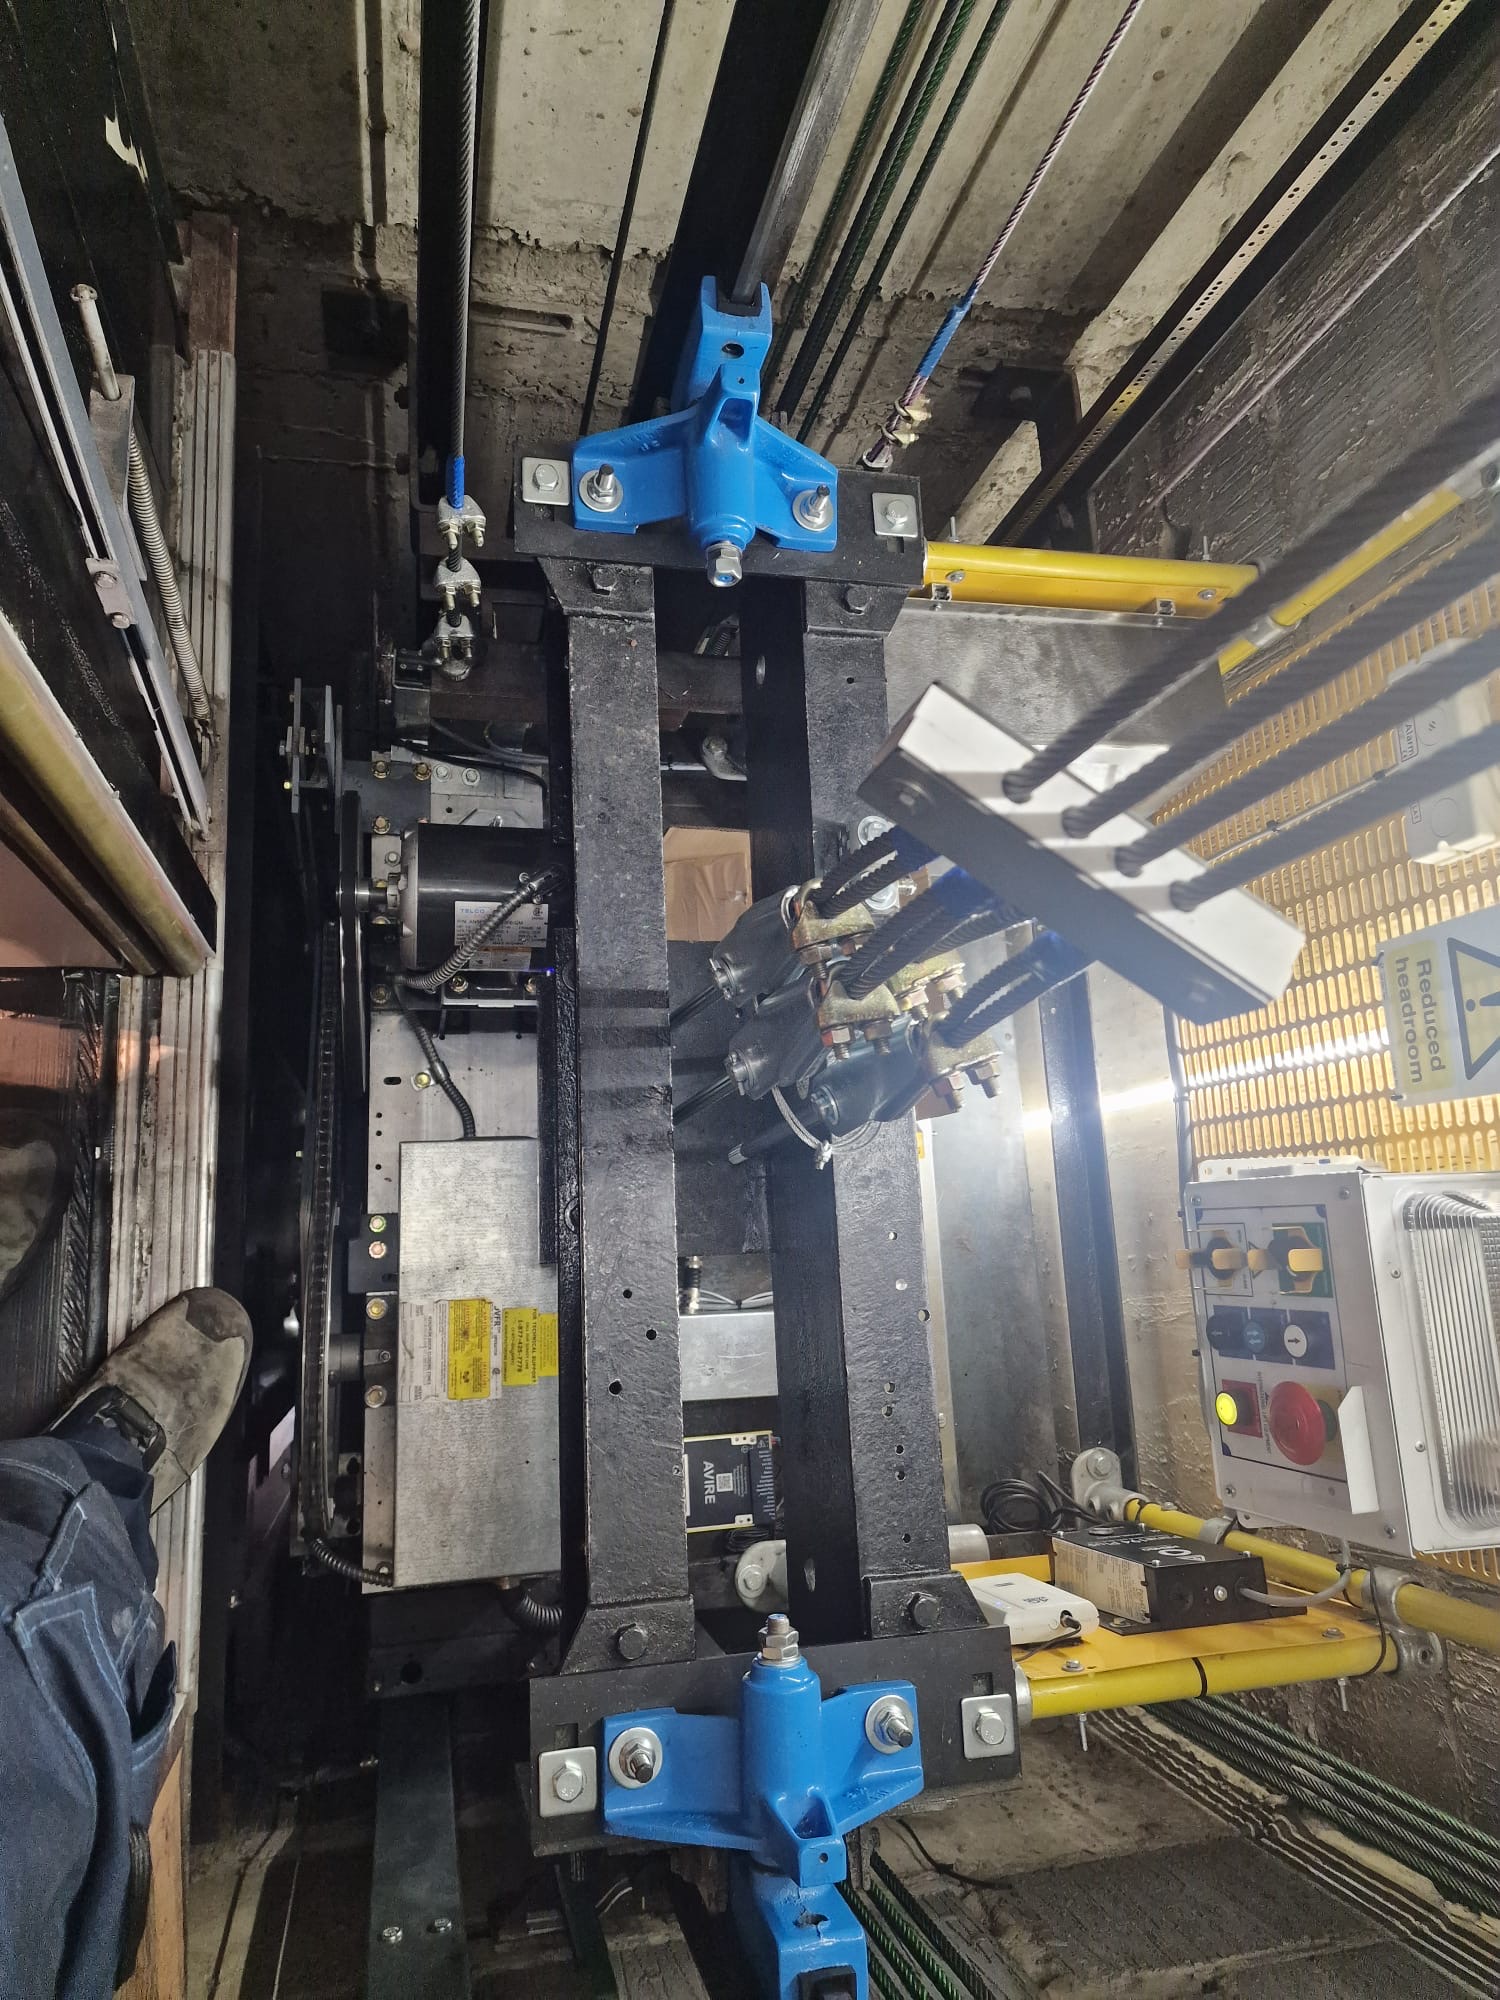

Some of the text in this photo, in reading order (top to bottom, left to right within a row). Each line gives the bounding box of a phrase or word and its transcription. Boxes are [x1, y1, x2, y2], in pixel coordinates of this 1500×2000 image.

[1405, 723, 1414, 757] Alarm
[1395, 956, 1422, 1083] headroom
[1417, 958, 1446, 1072] Reduced
[703, 1461, 716, 1505] AVIRE
